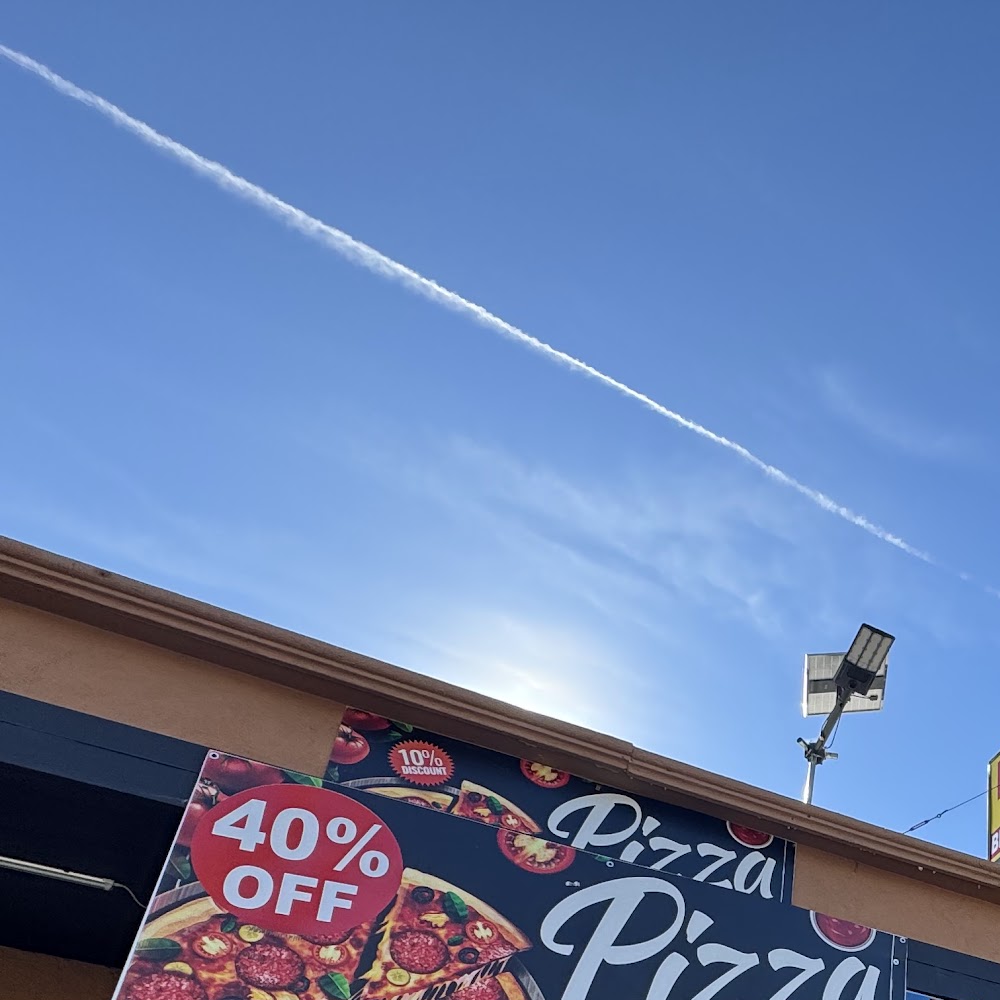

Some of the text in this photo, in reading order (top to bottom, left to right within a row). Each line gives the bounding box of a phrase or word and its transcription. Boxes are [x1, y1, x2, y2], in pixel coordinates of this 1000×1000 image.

[398, 748, 443, 767] 10%
[401, 765, 447, 776] DISCOUNT
[210, 798, 390, 878] 40%
[222, 864, 358, 924] OFF
